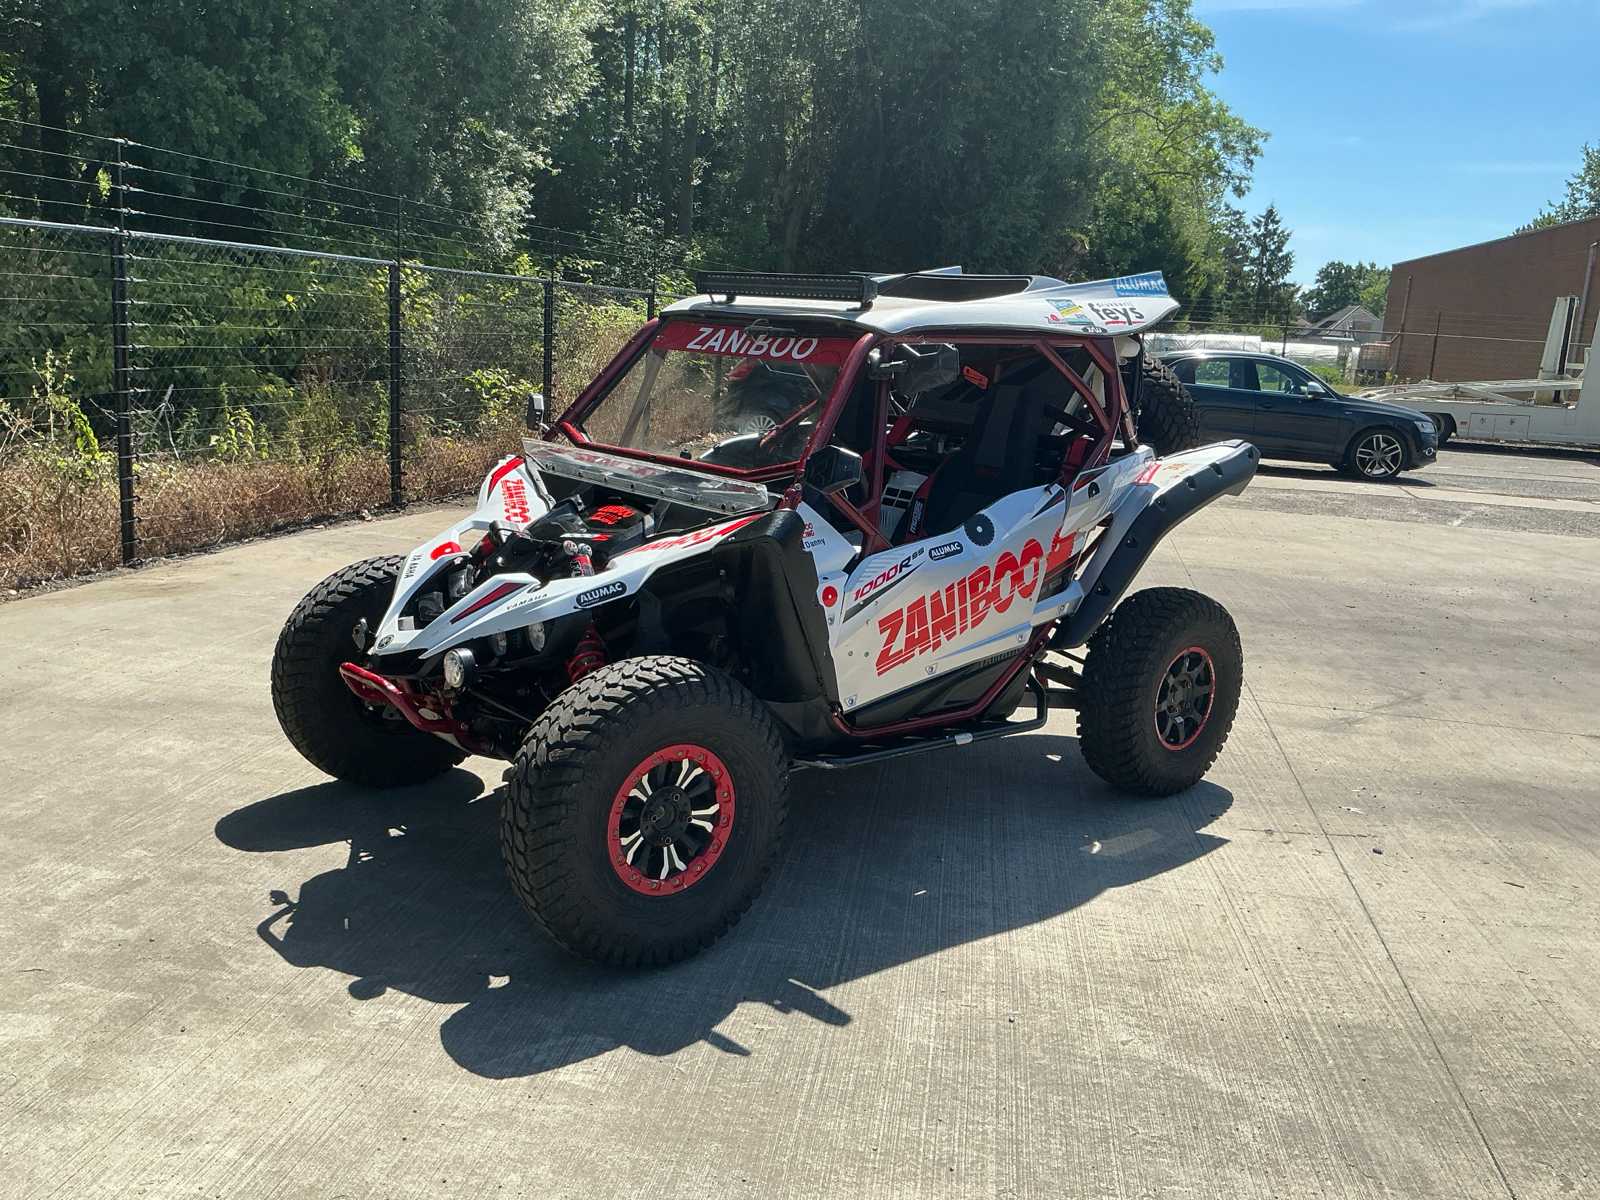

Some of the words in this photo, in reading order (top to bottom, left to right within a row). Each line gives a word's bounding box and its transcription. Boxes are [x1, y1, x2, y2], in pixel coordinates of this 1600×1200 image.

[1115, 278, 1168, 291] ALUMAC
[1088, 303, 1144, 325] feys
[501, 479, 531, 523] ZANIBOO
[805, 538, 826, 548] Danny
[931, 541, 961, 558] ALUMAC
[854, 556, 912, 601] 1000R
[580, 582, 623, 603] ALUMAC
[875, 538, 1043, 677] ZANIBOO
